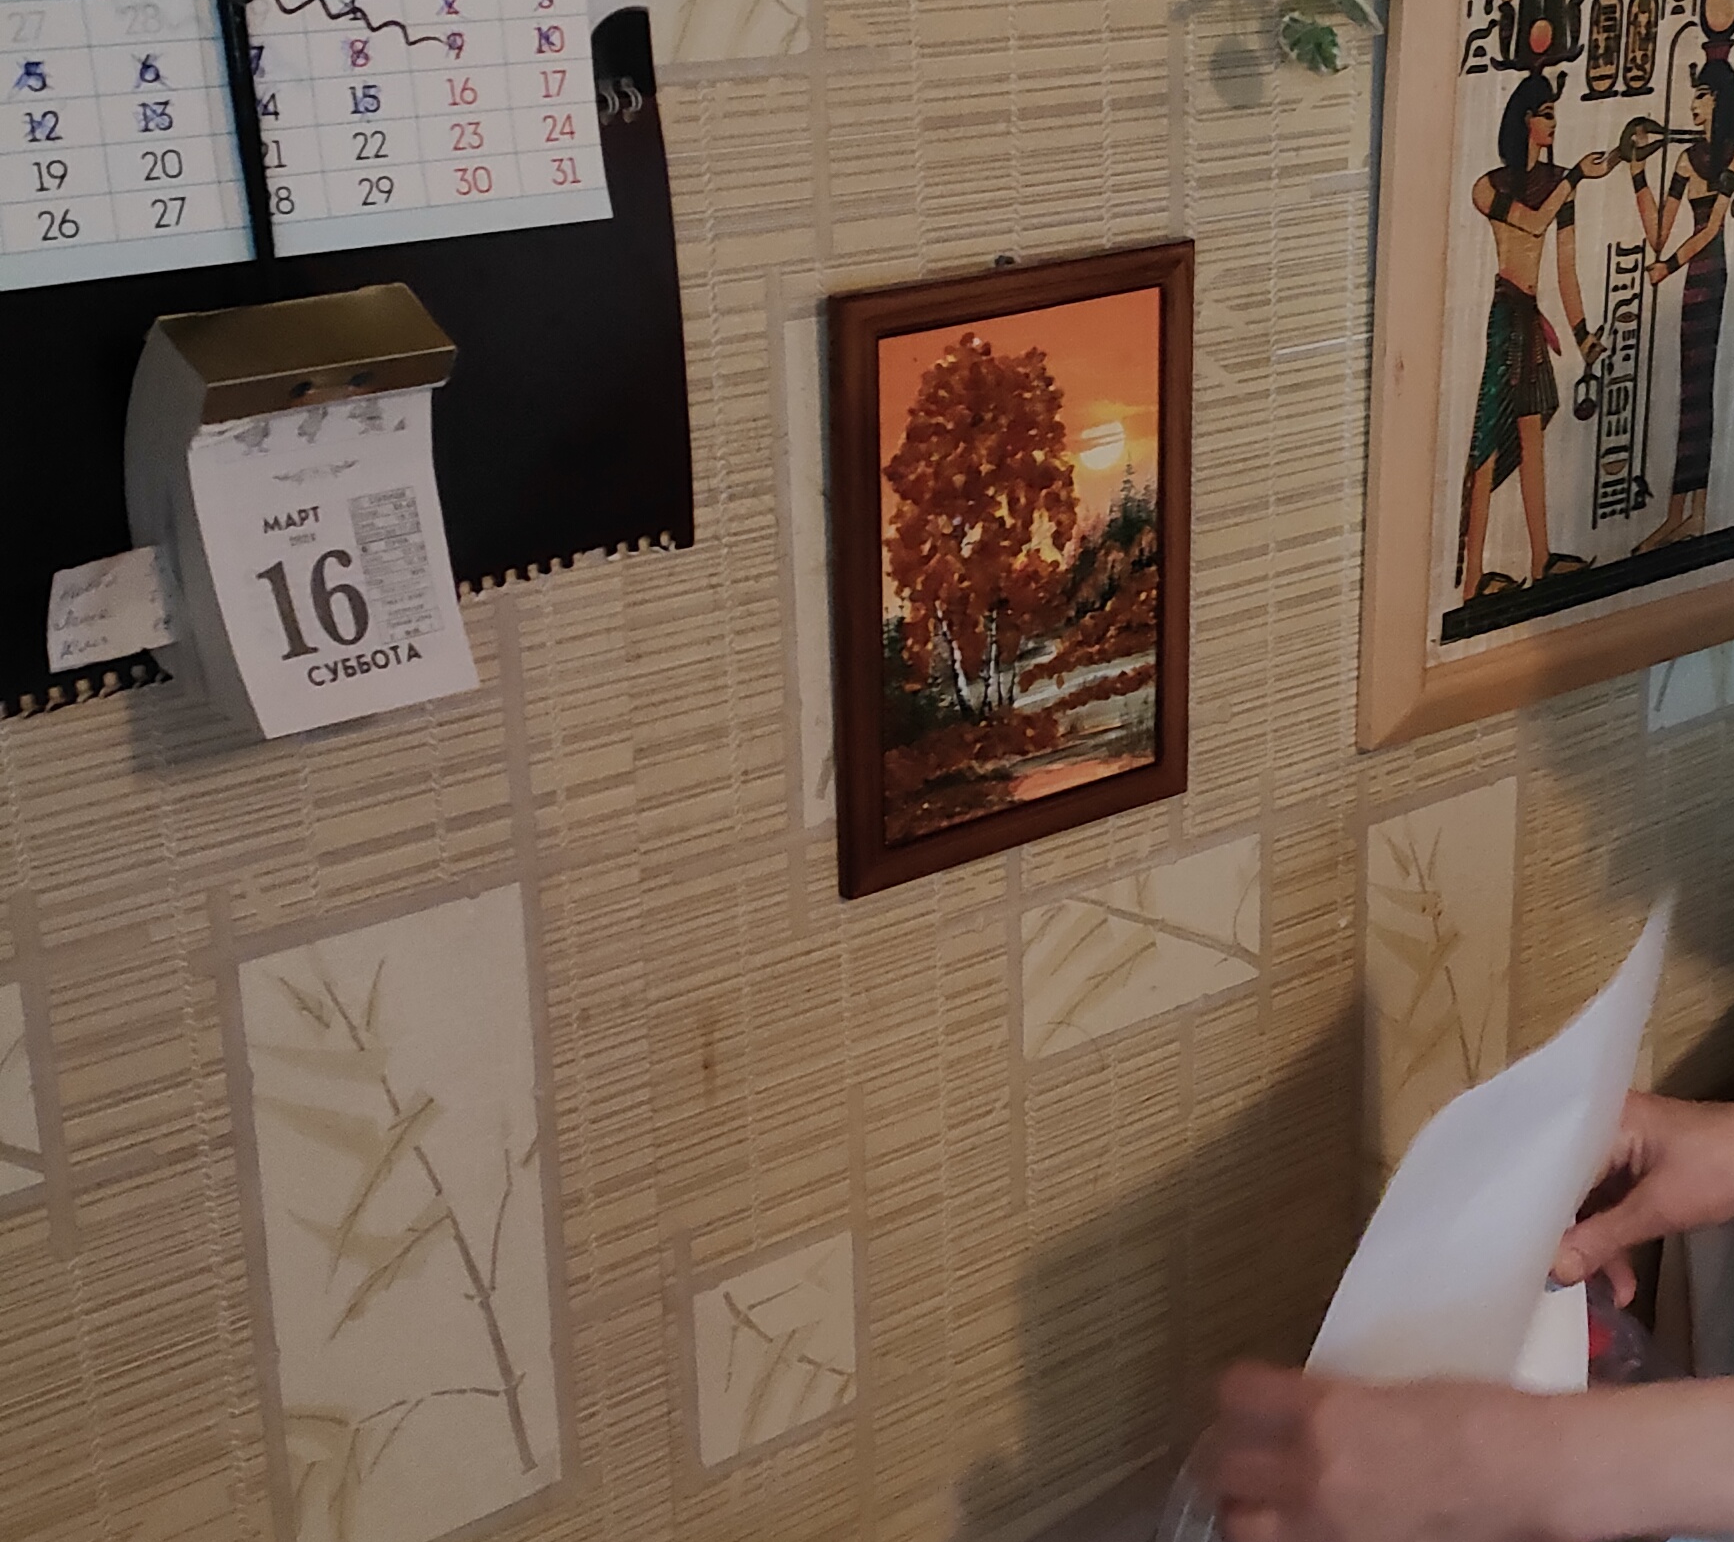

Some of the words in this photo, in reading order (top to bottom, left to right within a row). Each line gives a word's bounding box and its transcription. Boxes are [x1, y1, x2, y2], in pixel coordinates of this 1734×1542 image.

[24, 61, 47, 92] 5
[139, 53, 161, 84] 6
[350, 39, 370, 67] 8
[446, 32, 465, 60] 9
[534, 25, 566, 54] 10
[24, 110, 64, 143] 12
[138, 100, 174, 133] 13
[348, 84, 382, 115] 15
[446, 77, 478, 107] 16
[540, 69, 567, 99] 17
[32, 159, 69, 193] 19
[141, 149, 184, 182] 20
[352, 130, 389, 161] 22
[450, 122, 485, 152] 23
[543, 113, 577, 143] 24
[37, 208, 81, 242] 26
[151, 196, 187, 229] 27
[269, 186, 295, 216] 8
[358, 175, 395, 207] 29
[454, 165, 494, 196] 30
[551, 157, 582, 186] 31
[262, 505, 320, 535] МАРТ
[255, 549, 370, 661] 16
[307, 641, 423, 687] СУББОТА
